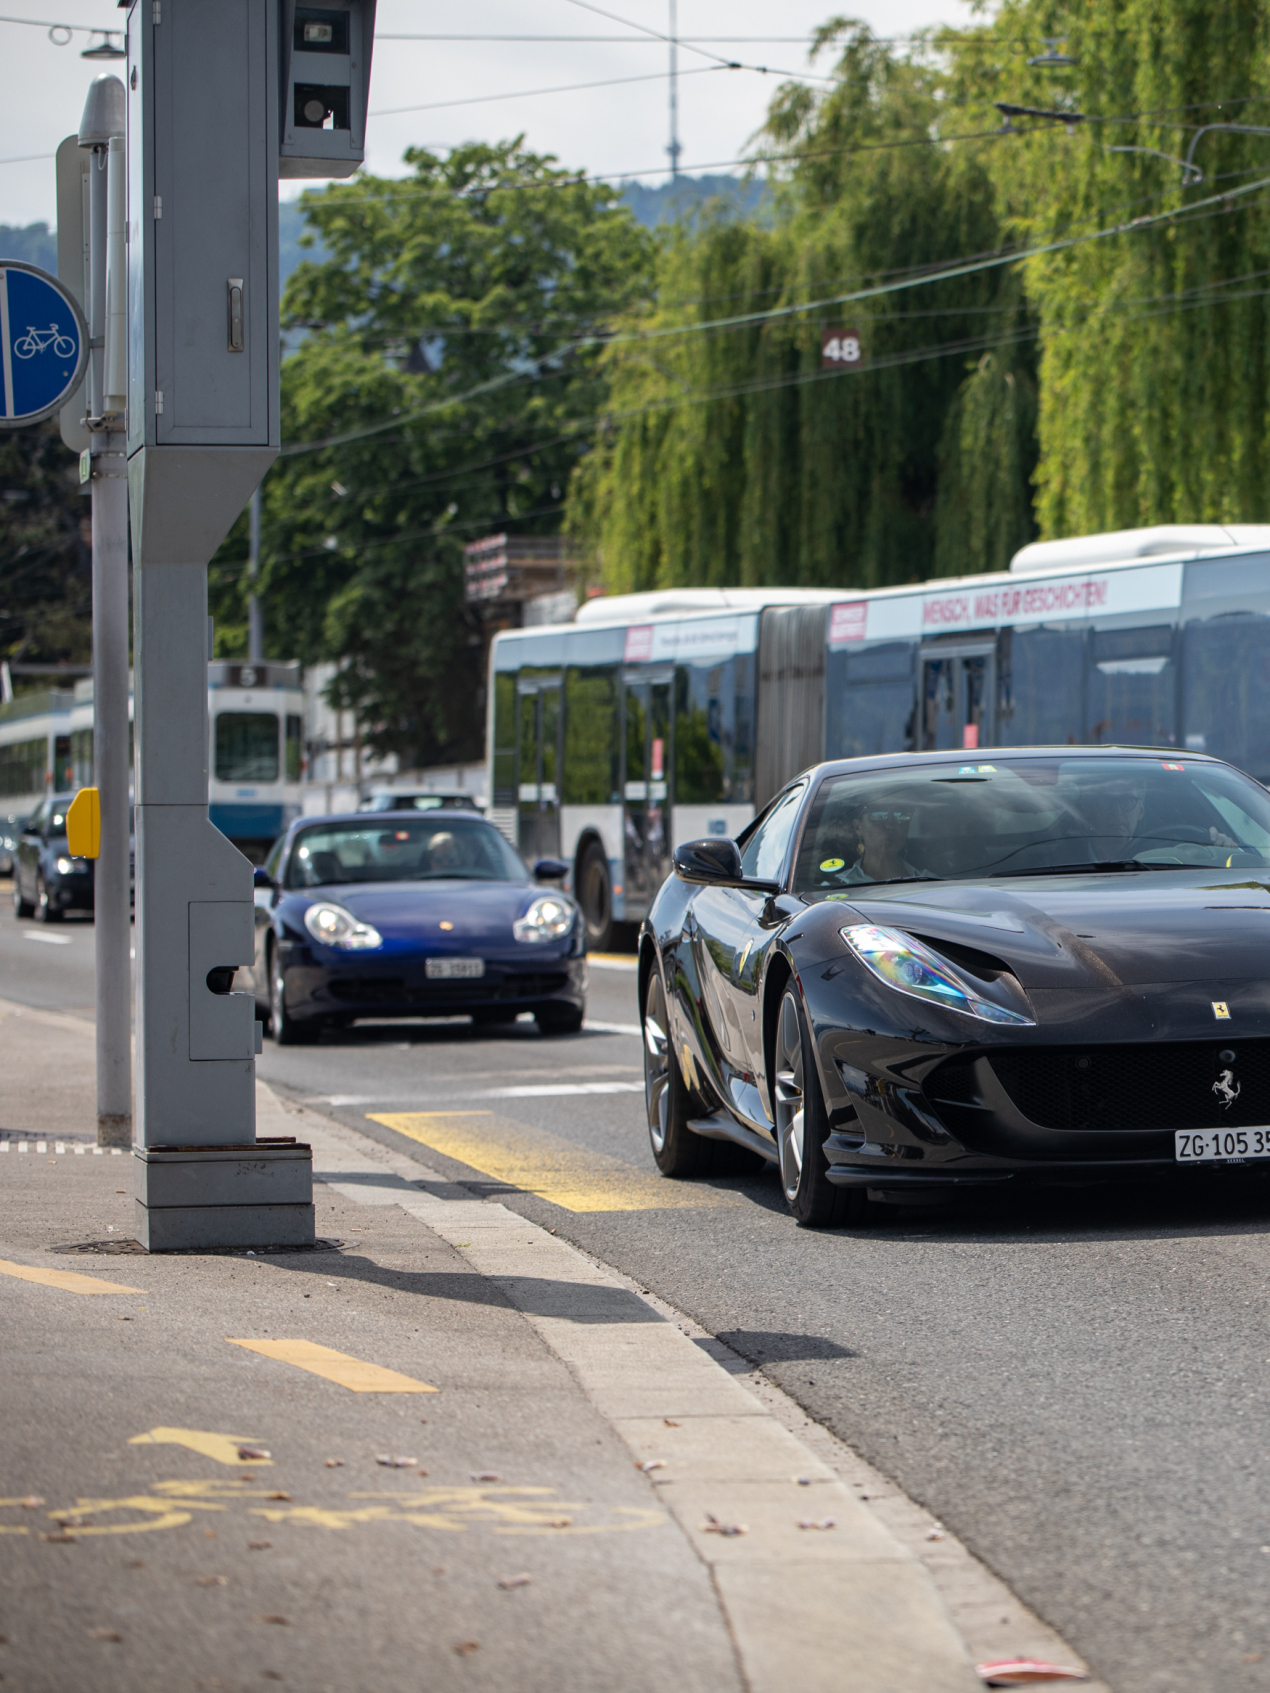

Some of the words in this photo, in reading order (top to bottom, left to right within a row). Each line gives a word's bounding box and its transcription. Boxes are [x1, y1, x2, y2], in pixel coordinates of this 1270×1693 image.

[822, 337, 861, 362] 48
[974, 593, 998, 619] WAS
[1001, 584, 1021, 616] FÜR
